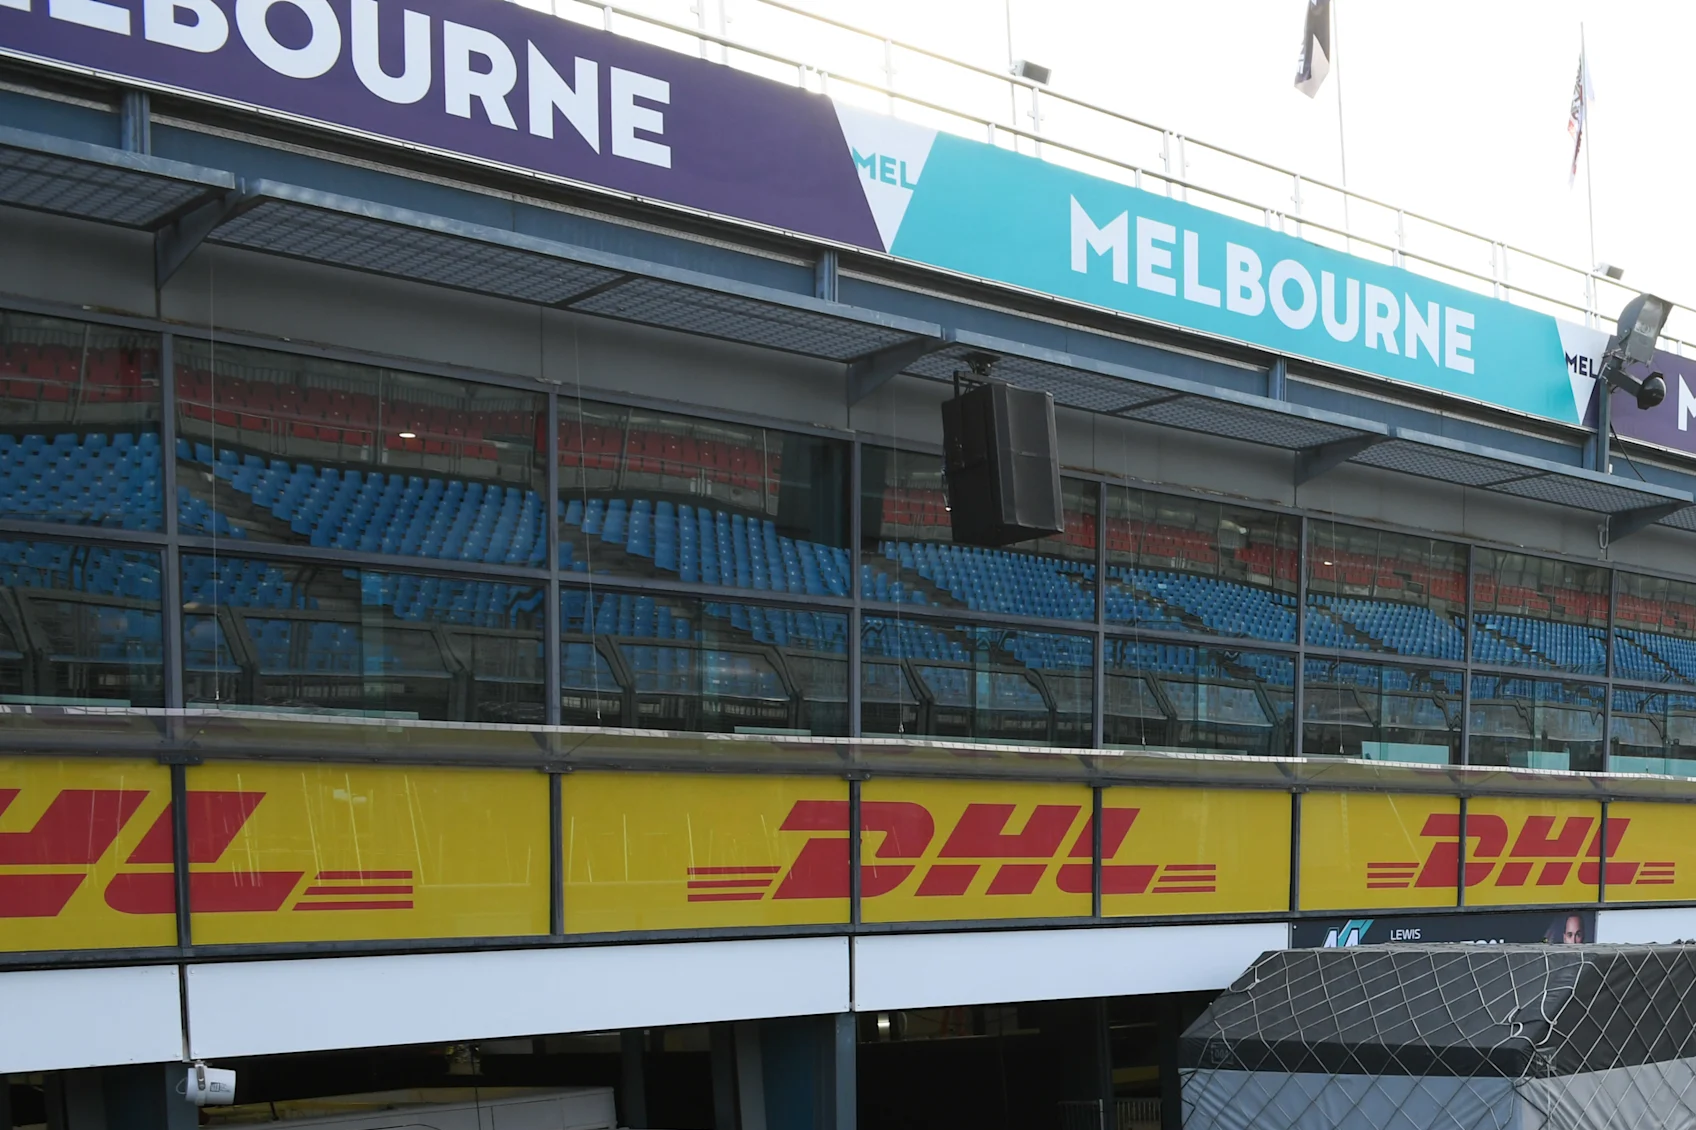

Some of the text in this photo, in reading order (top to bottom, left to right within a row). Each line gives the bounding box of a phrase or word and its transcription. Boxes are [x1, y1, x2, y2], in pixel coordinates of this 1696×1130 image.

[853, 147, 915, 191] MEL
[1071, 194, 1475, 375] MELBOURNE
[1564, 351, 1598, 380] MEL
[0, 788, 305, 918] HL
[772, 800, 1157, 900] DHL
[1414, 813, 1639, 889] DHL
[1390, 929, 1421, 940] LEWIS
